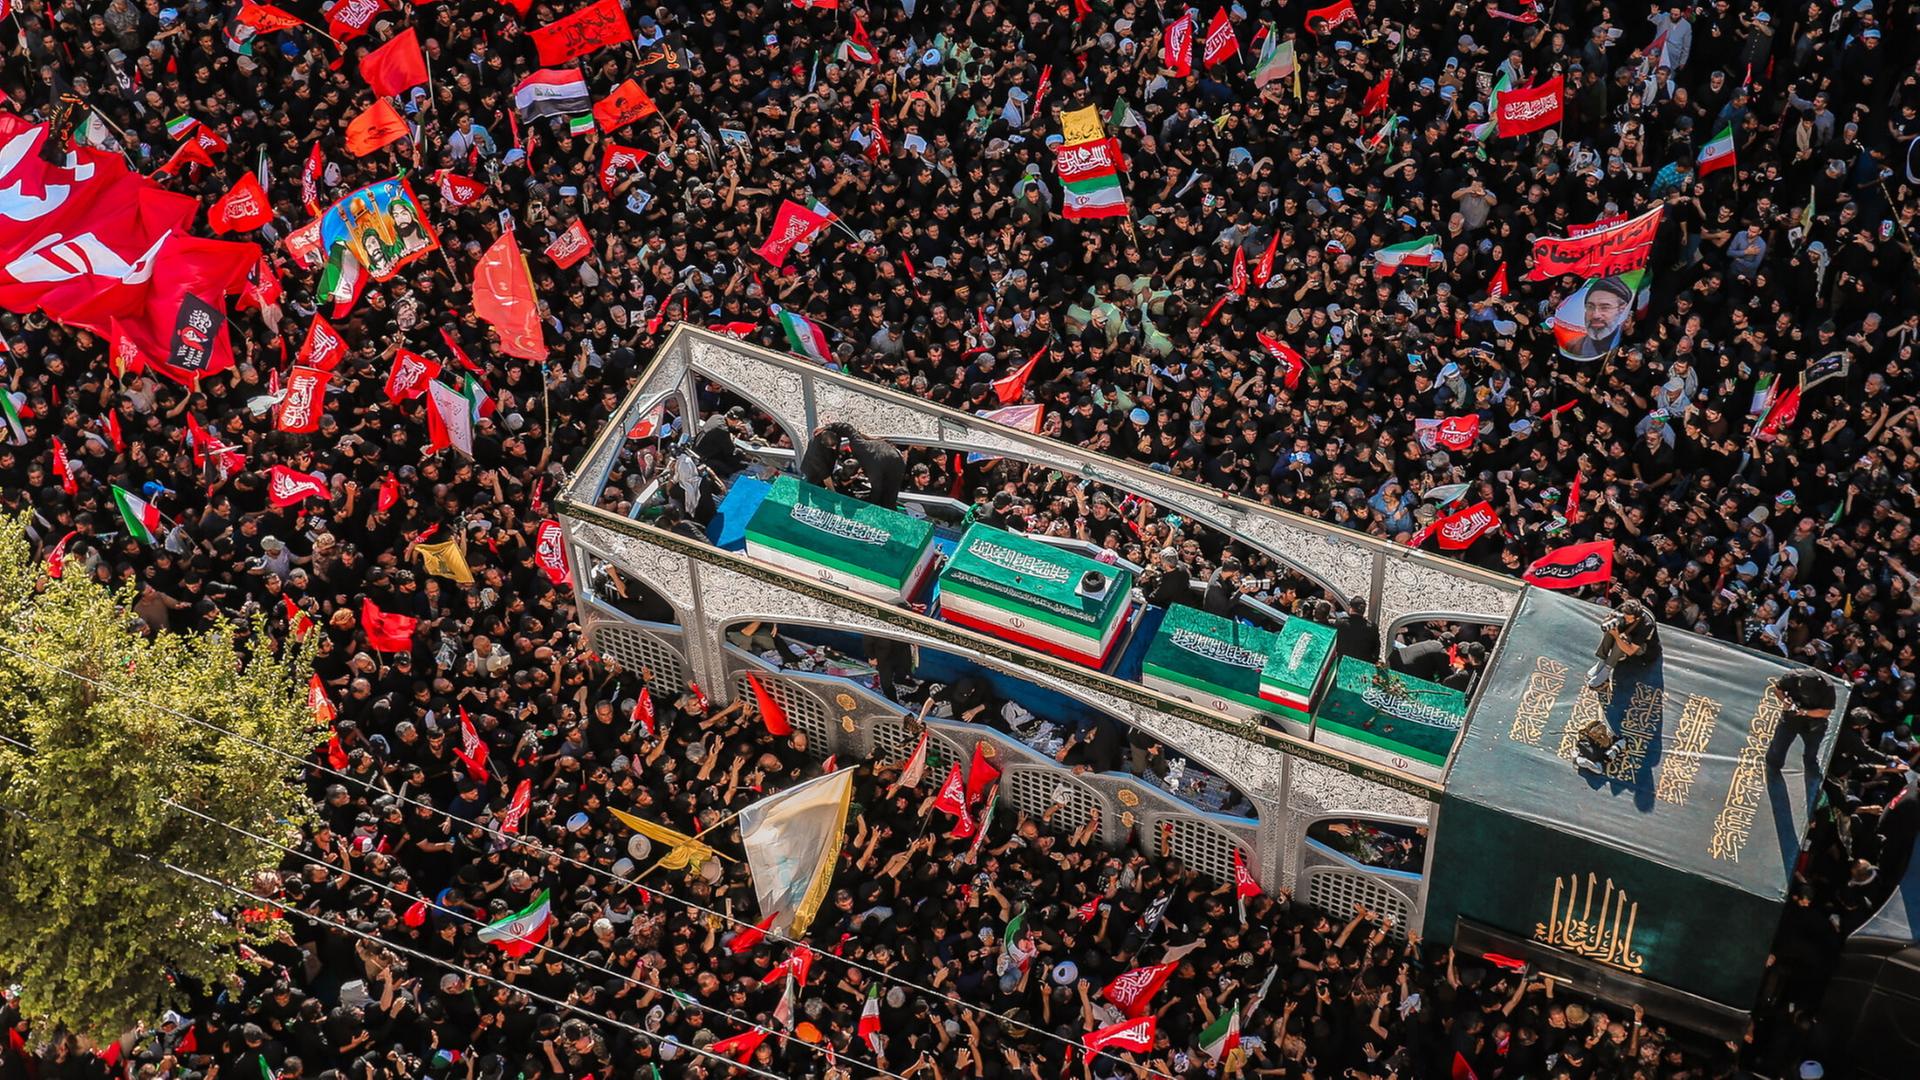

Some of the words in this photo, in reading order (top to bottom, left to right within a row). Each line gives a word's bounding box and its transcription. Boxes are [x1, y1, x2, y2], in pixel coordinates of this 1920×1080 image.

[177, 345, 188, 356] We
[182, 348, 196, 367] Must
[191, 351, 204, 367] Rise
